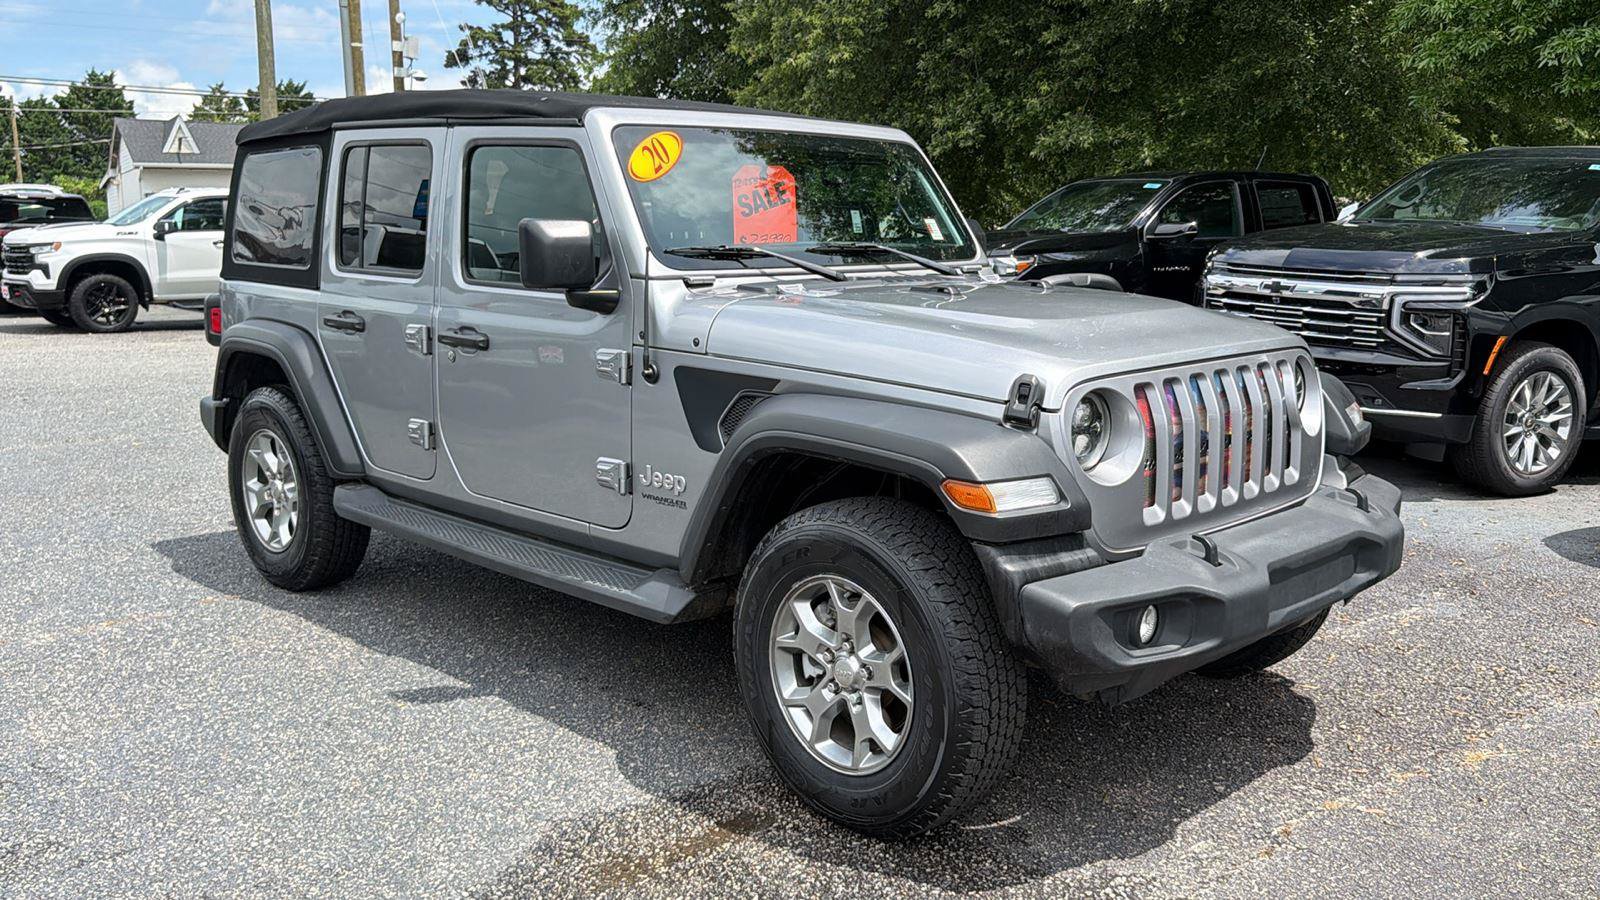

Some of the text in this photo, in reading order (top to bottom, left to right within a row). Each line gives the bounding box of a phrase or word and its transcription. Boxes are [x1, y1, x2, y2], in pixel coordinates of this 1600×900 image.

[642, 137, 670, 175] 20
[737, 181, 791, 218] SALE
[640, 464, 687, 497] Jeep
[641, 492, 688, 507] WRANGLER
